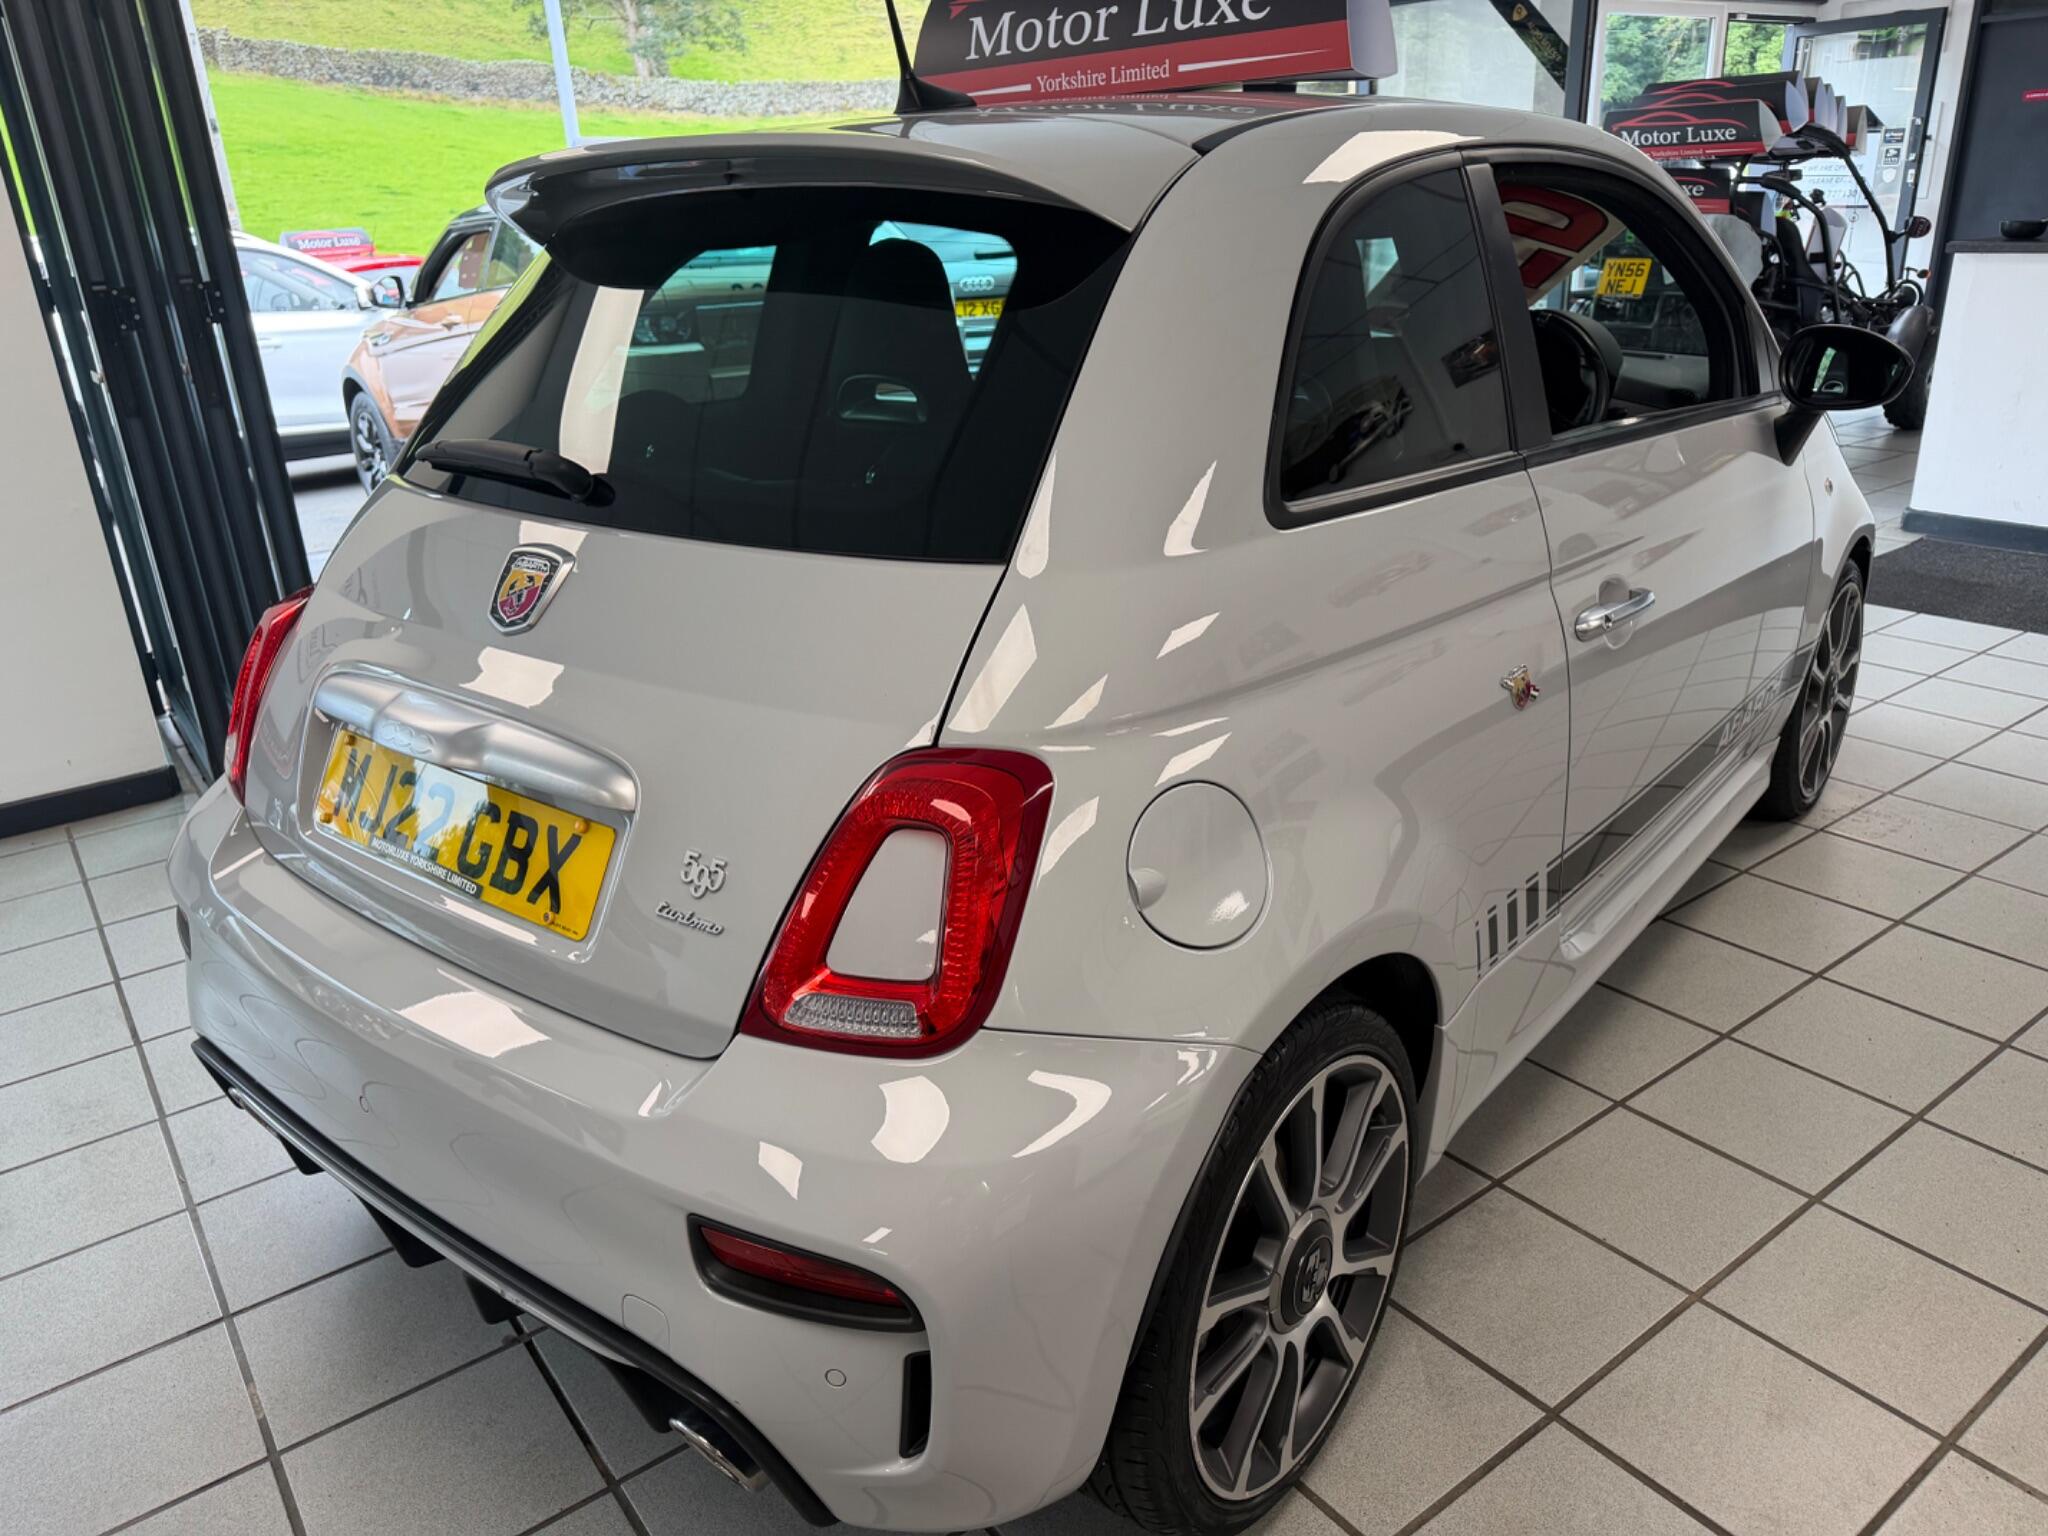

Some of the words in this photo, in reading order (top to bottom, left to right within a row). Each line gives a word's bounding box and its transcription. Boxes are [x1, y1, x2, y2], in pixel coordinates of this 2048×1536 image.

[965, 5, 1119, 60] Motor
[1035, 68, 1106, 93] Yorkshire
[1111, 58, 1170, 84] Limited
[1620, 130, 1681, 147] Motor
[1687, 126, 1737, 144] Luxe
[1604, 279, 1637, 294] NEJ
[1607, 262, 1646, 277] YN56
[410, 854, 448, 880] YORKSHIRE
[447, 870, 477, 895] LIMITED
[456, 800, 583, 915] GBX
[680, 849, 727, 899] 595
